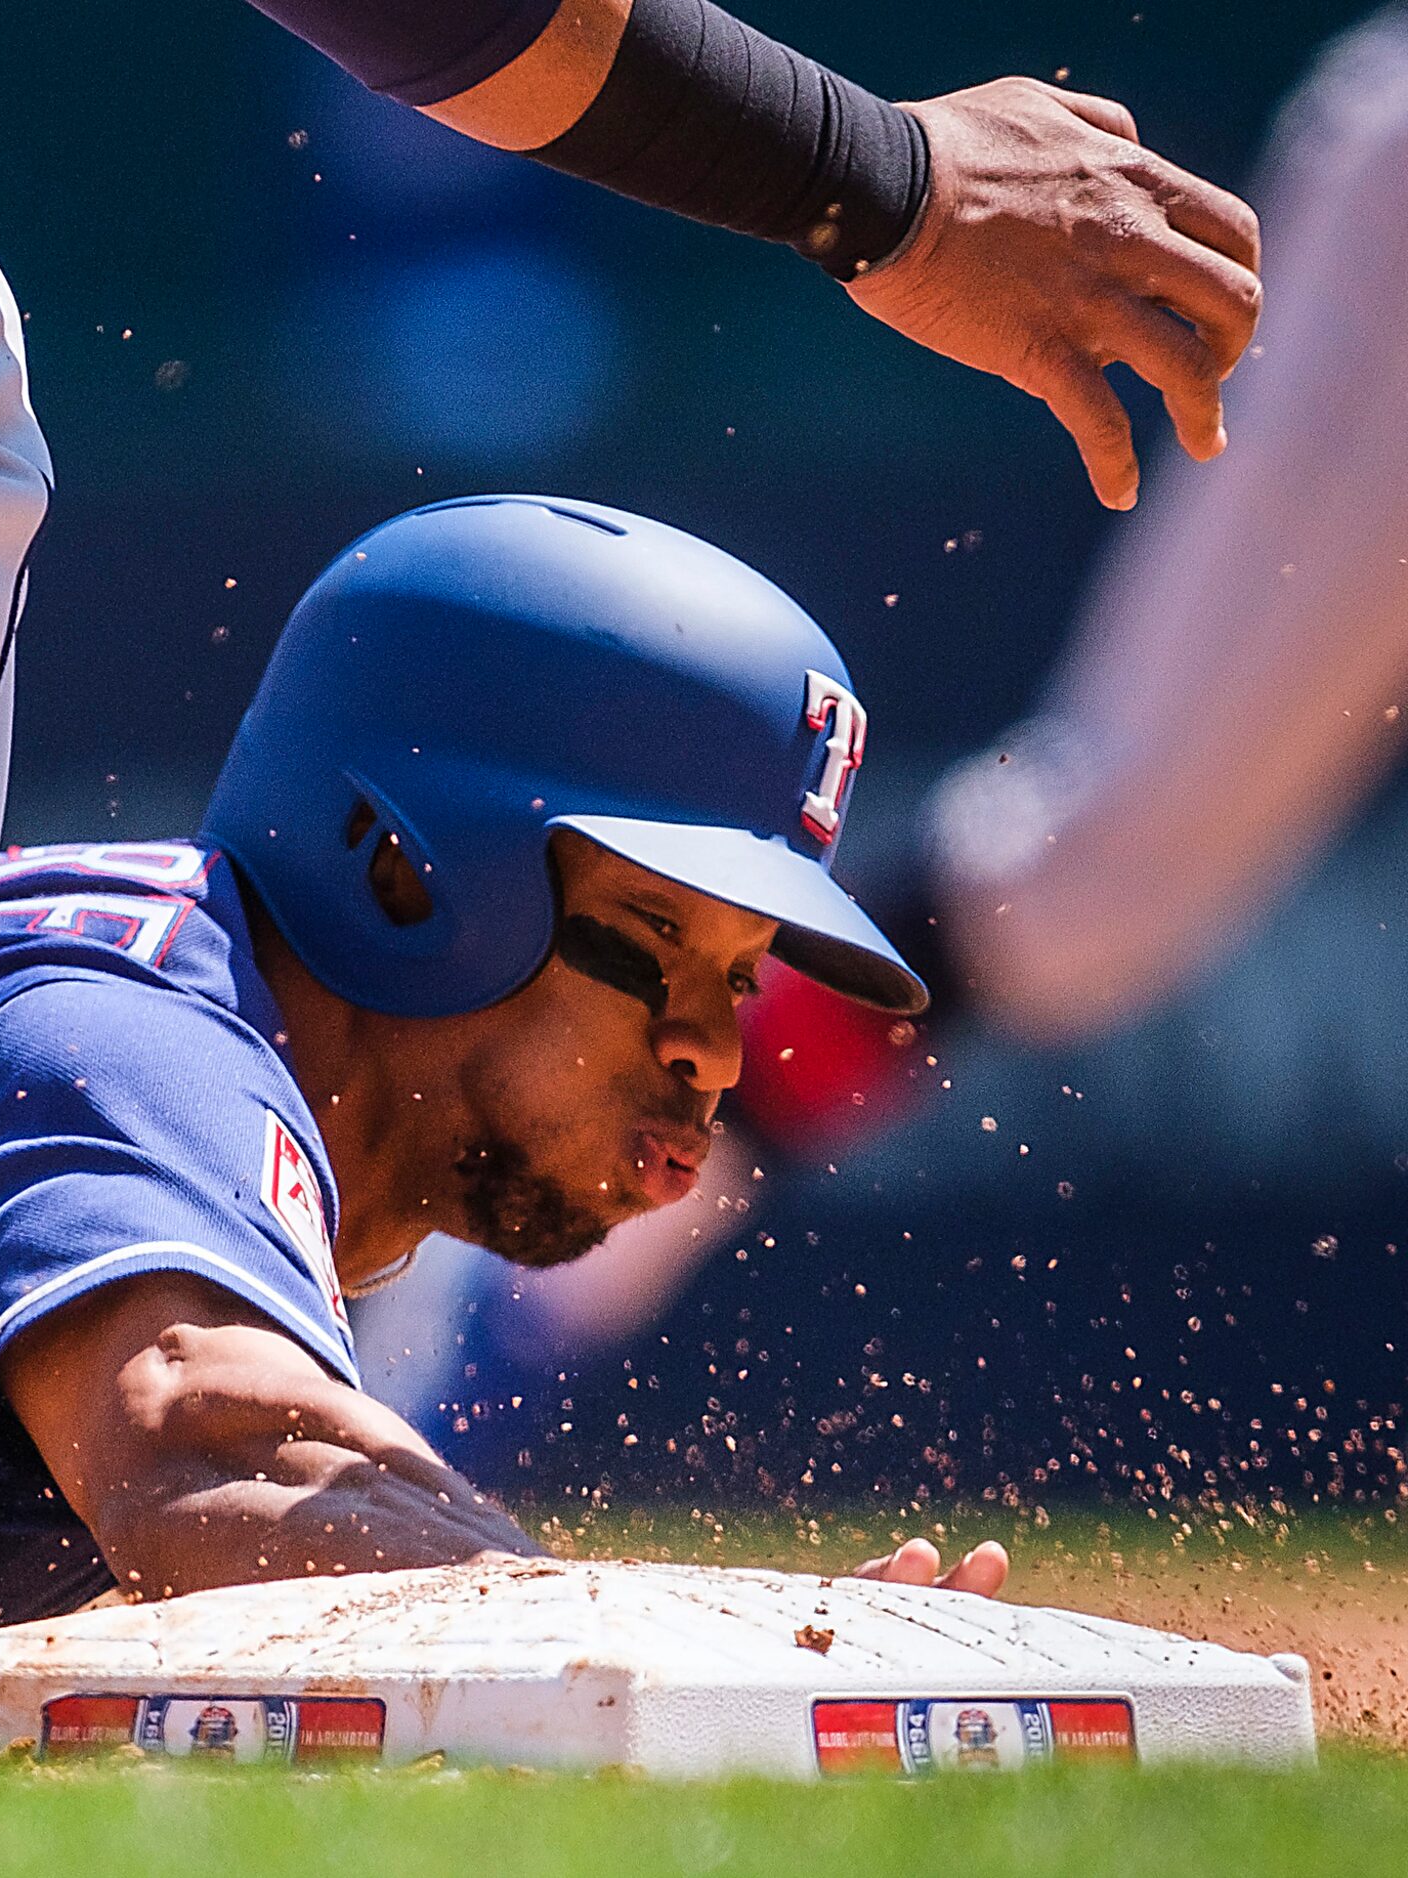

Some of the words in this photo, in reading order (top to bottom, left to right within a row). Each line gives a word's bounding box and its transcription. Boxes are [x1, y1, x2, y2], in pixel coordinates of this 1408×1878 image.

[800, 668, 868, 846] T
[49, 1725, 80, 1741] GLOBE
[300, 1729, 313, 1746] IN
[316, 1729, 378, 1746] ARLINGTON
[817, 1731, 849, 1748] GLOBE
[909, 1713, 931, 1764] 1994
[1055, 1730, 1069, 1746] IN
[1071, 1730, 1129, 1747] ARLINGTON
